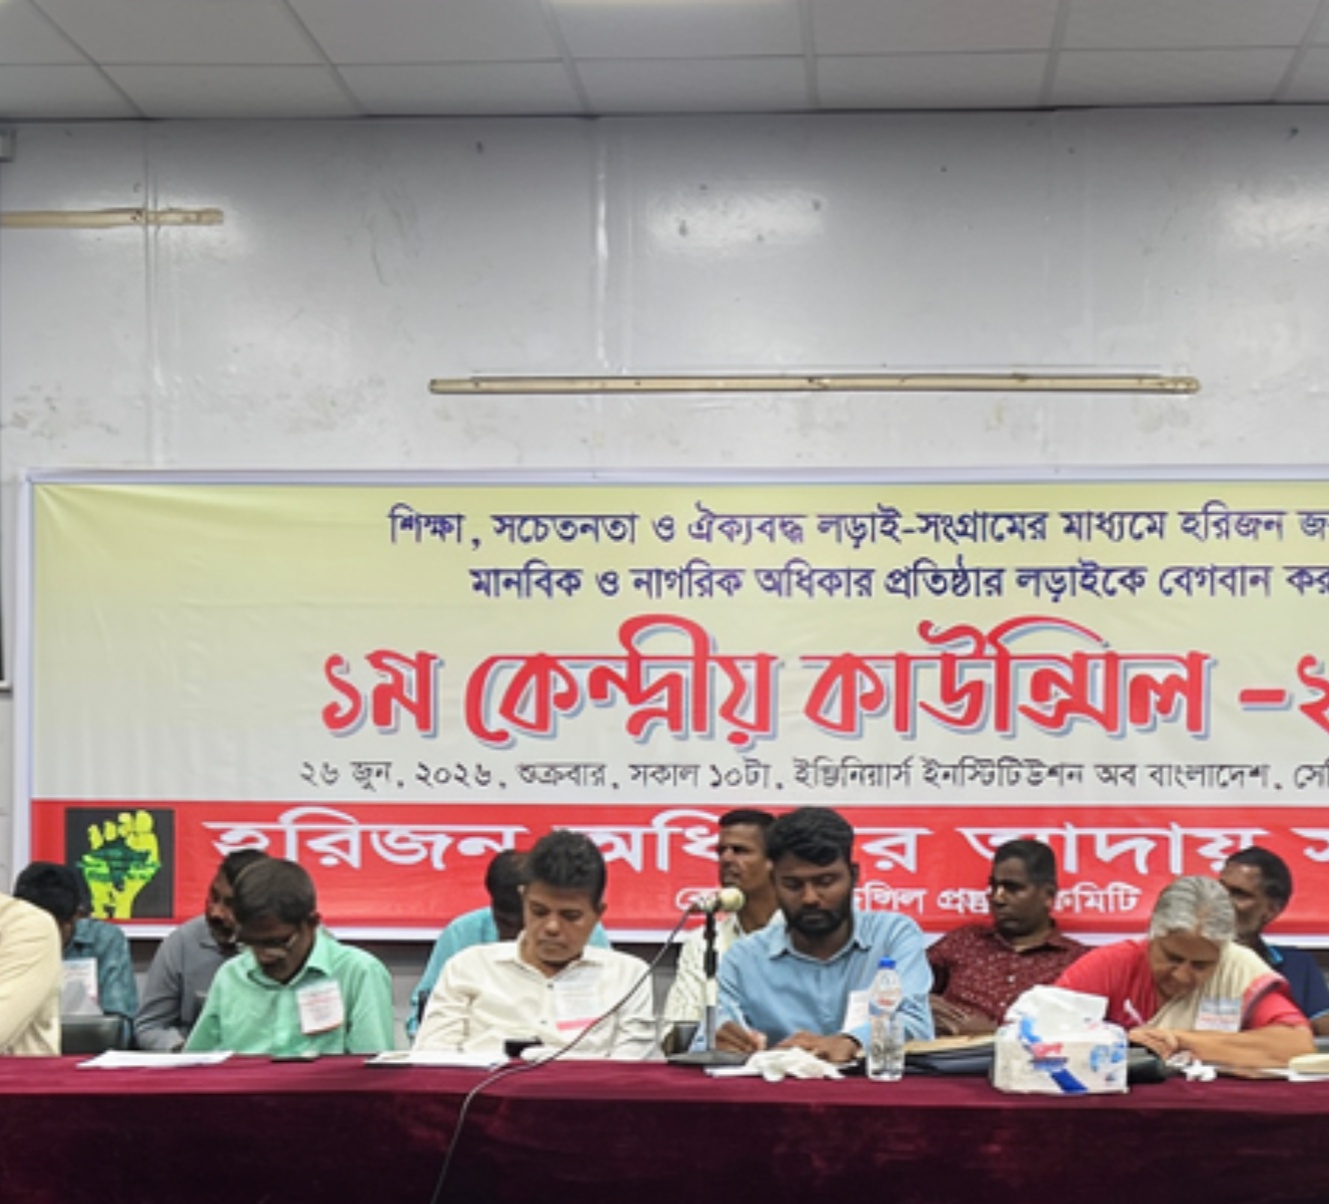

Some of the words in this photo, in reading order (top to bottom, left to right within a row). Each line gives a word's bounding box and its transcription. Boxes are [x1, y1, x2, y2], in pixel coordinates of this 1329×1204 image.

[388, 502, 480, 550] শিক্ষা,
[491, 512, 639, 544] সচেতনতা
[652, 513, 675, 542] ও
[688, 502, 807, 546] ঐক্যবদ্ধ
[817, 502, 1049, 548] লড়াই-সংগ্রামের
[1060, 510, 1169, 542] মাধ্যমে
[1178, 500, 1287, 542] হরিজন
[469, 558, 584, 598] মানবিক
[595, 568, 620, 597] ও
[629, 557, 745, 599] নাগরিক
[755, 557, 876, 599] অধিকার
[884, 555, 1006, 598] প্রতিষ্ঠার
[1015, 557, 1148, 602] লড়াইকে
[1158, 563, 1274, 598] বেগবান
[321, 649, 444, 738] ১ম
[463, 613, 782, 748] কেন্দ্রীয়
[799, 615, 1216, 738] কাউন্সিল
[299, 761, 340, 786] ২৬
[628, 763, 702, 788] সকাল
[922, 755, 1085, 789] ইনস্টিটিউশন
[1093, 763, 1138, 788] অব
